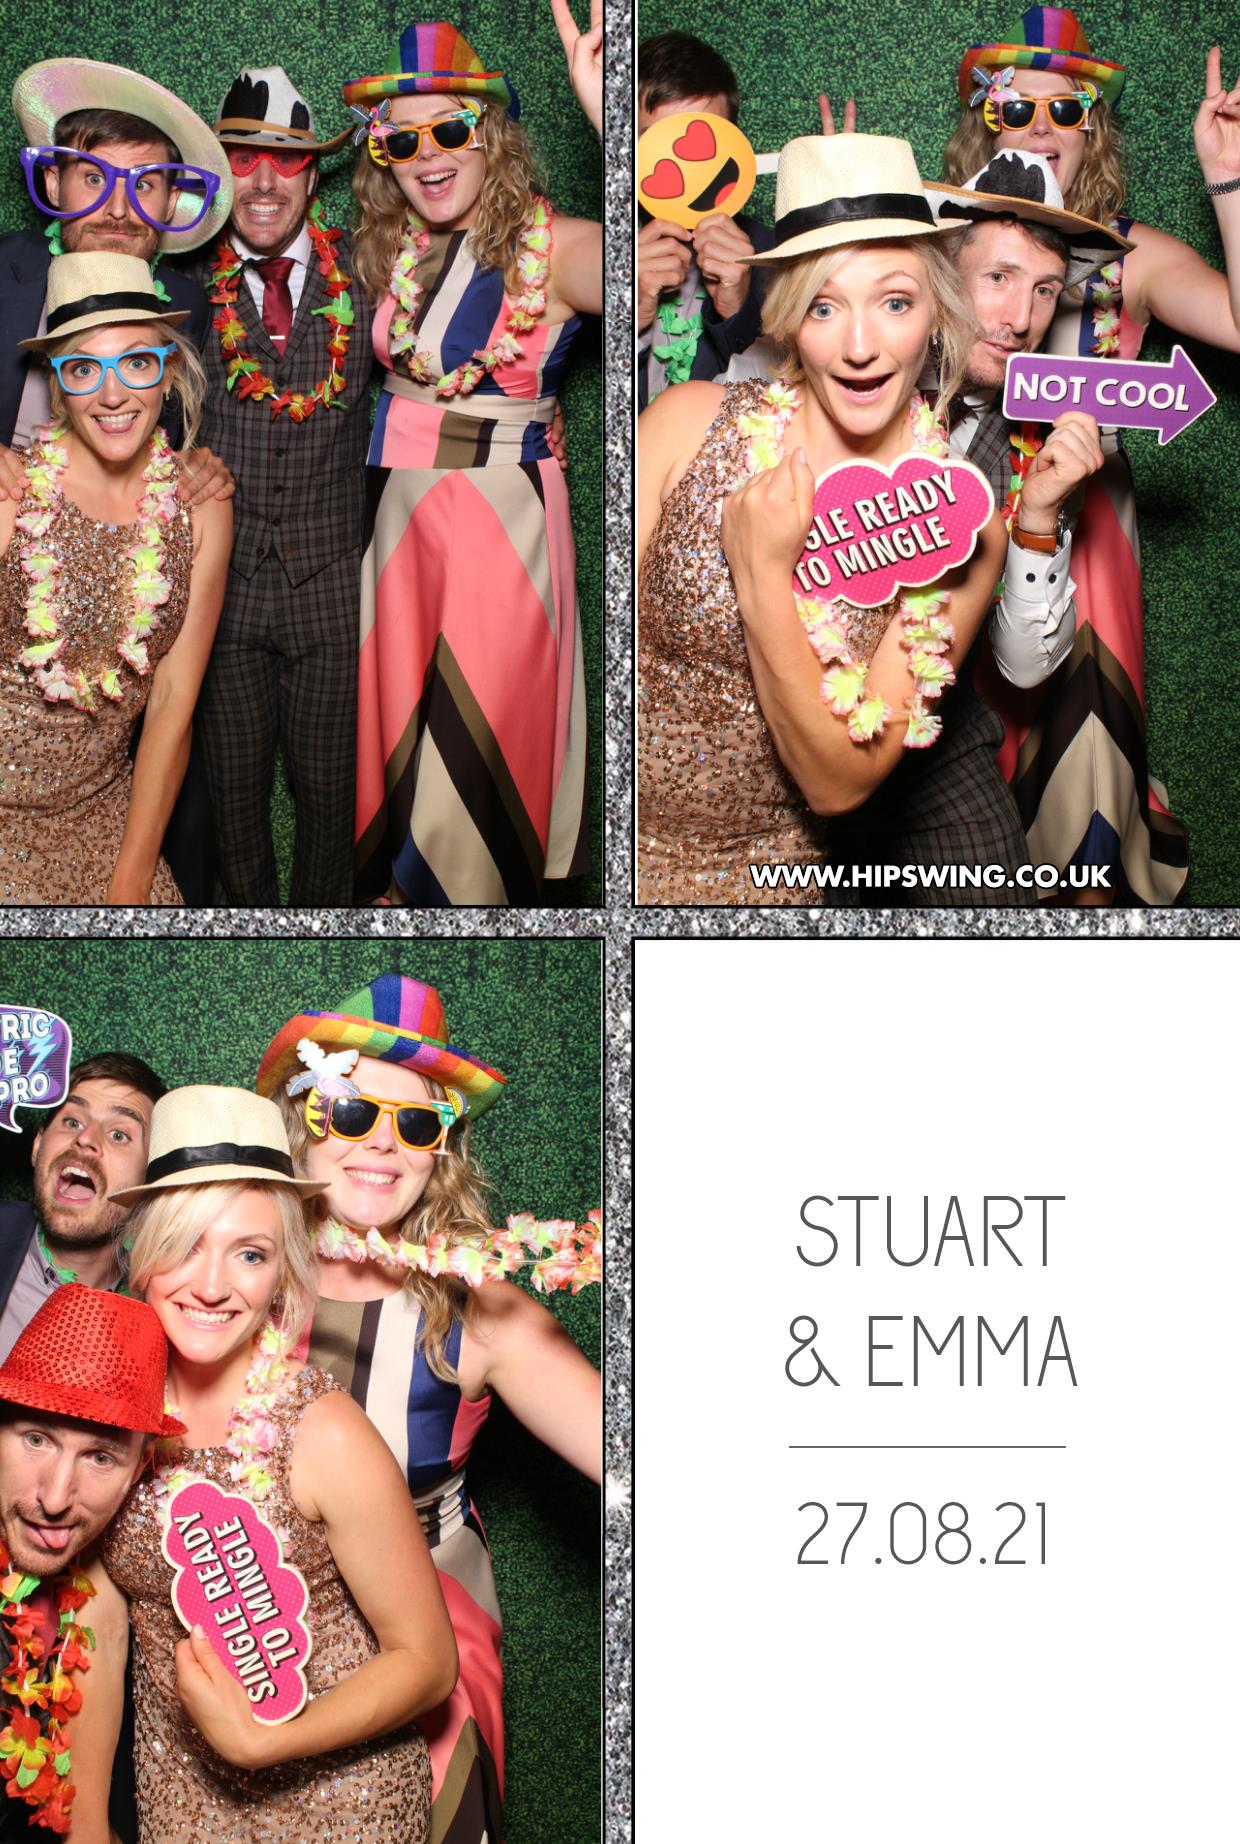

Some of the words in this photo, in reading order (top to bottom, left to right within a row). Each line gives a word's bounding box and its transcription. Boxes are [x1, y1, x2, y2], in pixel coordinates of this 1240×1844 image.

[1013, 372, 1087, 404] NOT
[1095, 378, 1190, 412] COOL
[854, 470, 956, 532] READY
[794, 556, 832, 592] TO
[832, 515, 951, 579] MINGLE
[173, 1511, 234, 1602] READY
[213, 1515, 281, 1625] MINGLE
[213, 1602, 278, 1704] SINGLE
[261, 1627, 298, 1669] TO
